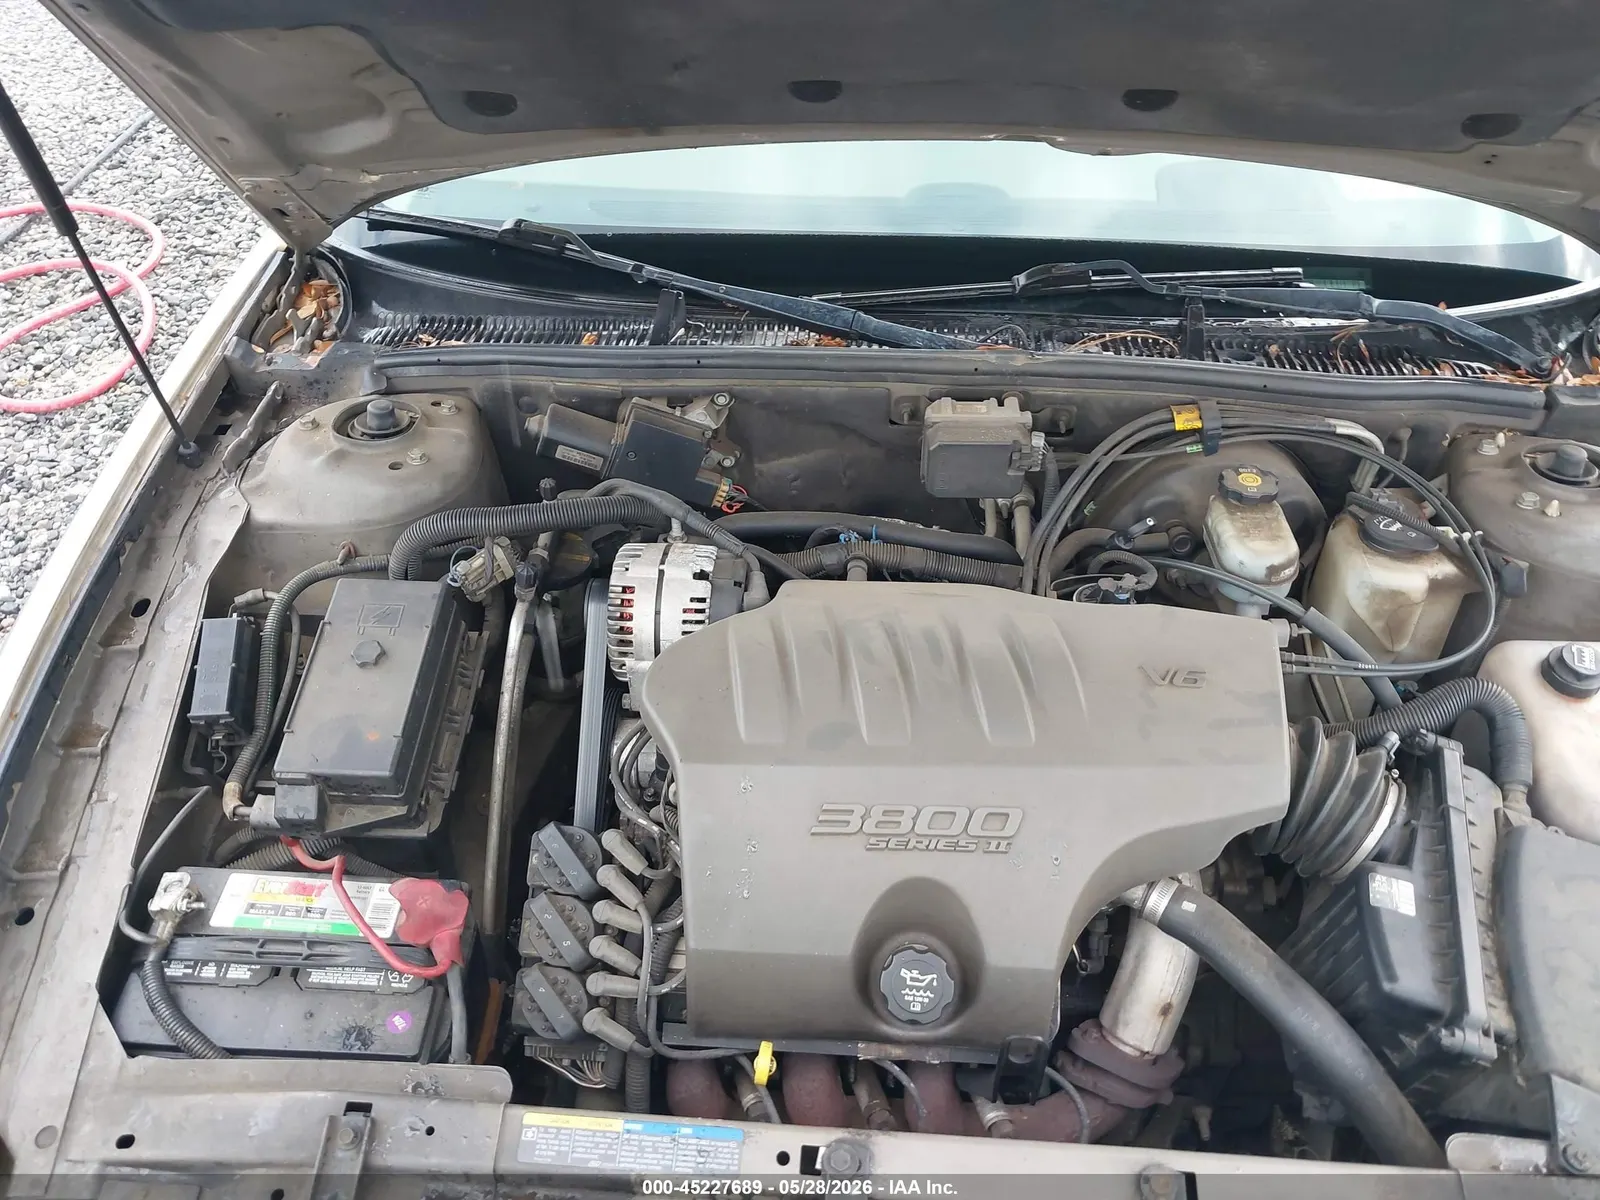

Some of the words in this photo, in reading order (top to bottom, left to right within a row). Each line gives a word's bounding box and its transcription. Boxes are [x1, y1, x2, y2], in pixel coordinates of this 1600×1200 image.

[1137, 664, 1207, 689] V6
[810, 803, 1024, 837] 3800
[865, 837, 978, 852] SERIES
[982, 840, 1012, 854] II
